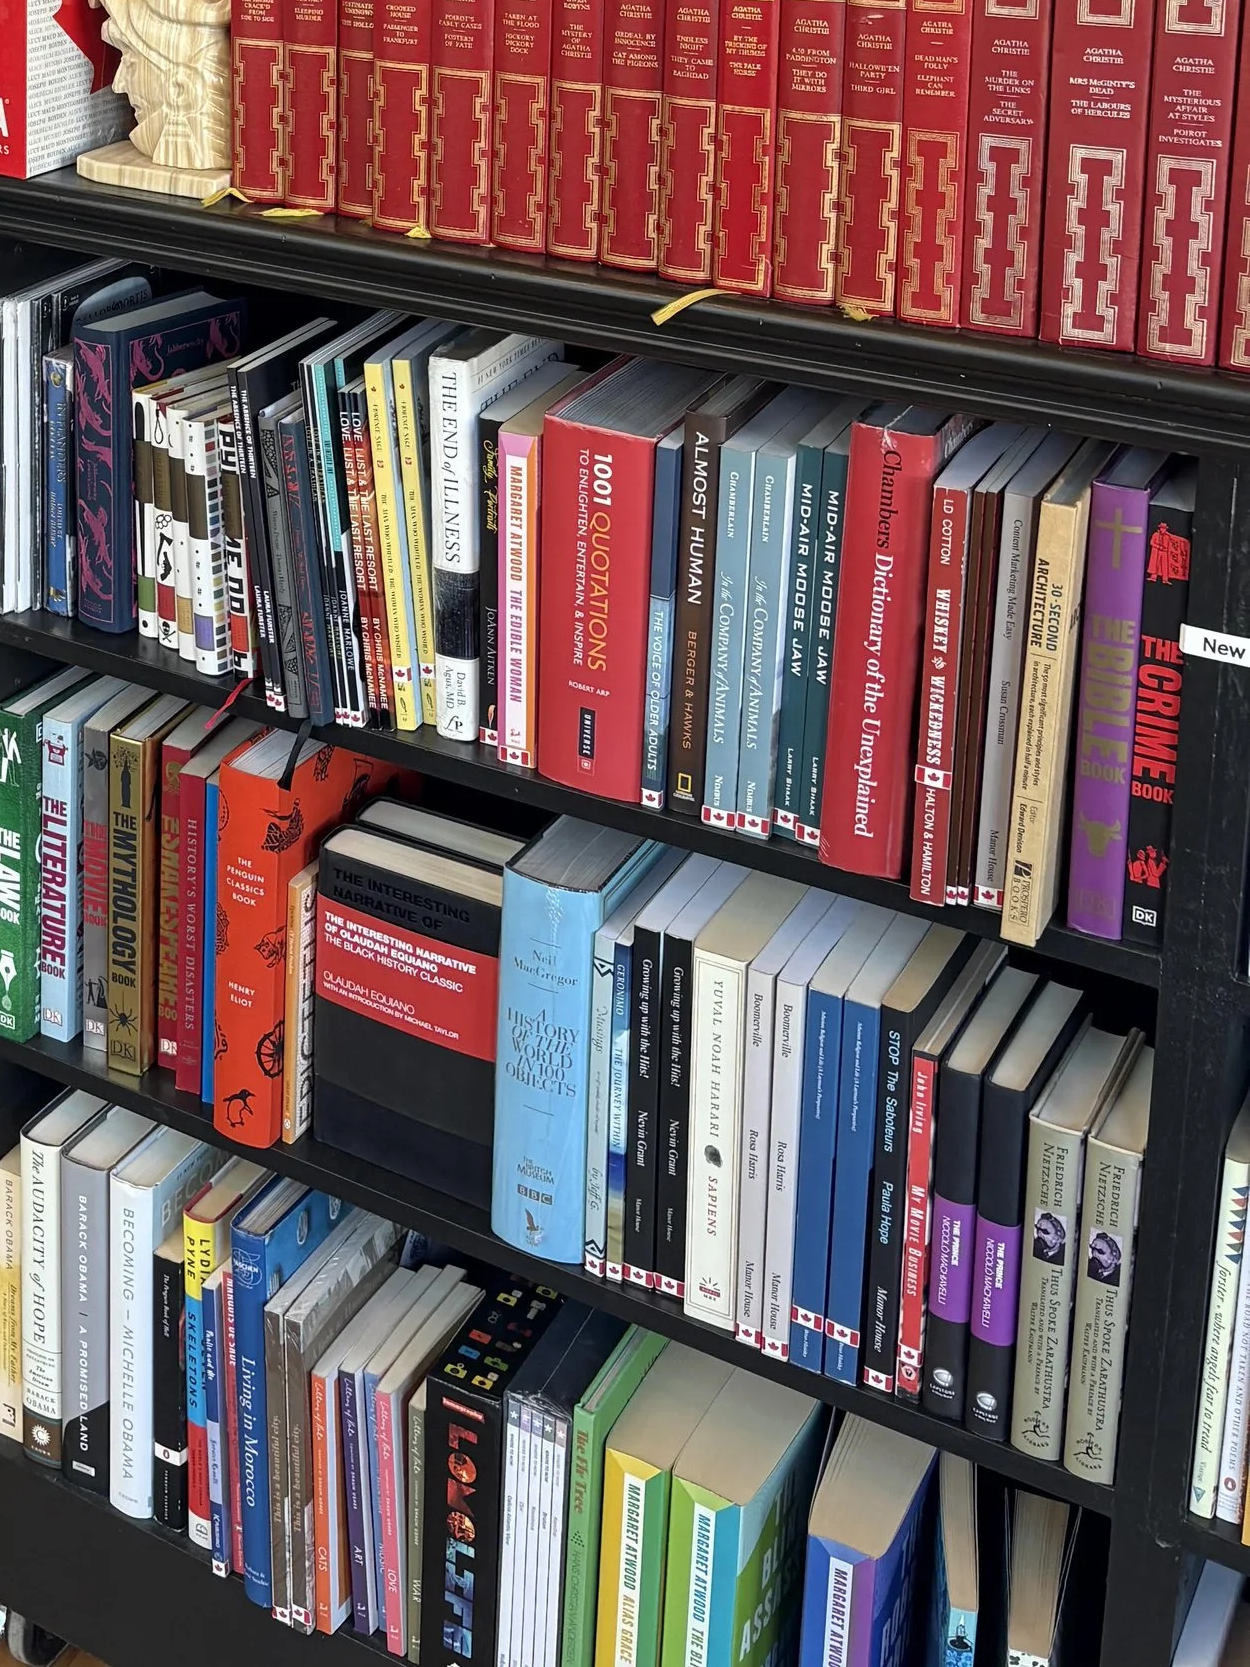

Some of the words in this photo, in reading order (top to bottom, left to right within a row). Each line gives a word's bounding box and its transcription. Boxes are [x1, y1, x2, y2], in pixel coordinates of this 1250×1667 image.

[1083, 55, 1124, 64] CHRISTIE
[1085, 48, 1122, 56] AGATHA
[1173, 65, 1215, 74] CHRISTIE
[1175, 57, 1214, 65] AGATHA
[1071, 99, 1088, 107] THE
[1091, 101, 1131, 111] LABOURS
[1089, 86, 1114, 95] DEAD
[1164, 95, 1221, 106] MYSTERIOUS
[1175, 105, 1208, 113] AFFAIR
[1183, 89, 1201, 97] THE
[1085, 109, 1130, 119] HERCULES
[1174, 129, 1207, 137] POIROT
[1182, 114, 1215, 122] STYLES
[1159, 135, 1222, 147] INVESTIGATES
[441, 372, 457, 412] THE
[442, 418, 458, 459] END
[579, 448, 589, 466] TO
[443, 461, 456, 475] of
[593, 454, 613, 506] 1001
[692, 431, 710, 519] ALMOST
[510, 465, 523, 530] MARGARET
[577, 468, 589, 538] ENLIGHTEN,
[877, 449, 902, 550] Chambers
[943, 499, 954, 514] LD
[443, 478, 460, 563] ILLNESS
[797, 483, 813, 557] MID-AIR
[509, 532, 522, 582] ATWOOD
[940, 519, 953, 566] COTTON
[573, 540, 586, 606] ENTERTAIN,
[687, 526, 705, 604] HUMAN
[510, 590, 522, 611] THE
[587, 511, 611, 672] QUOTATIONS
[793, 563, 808, 632] MOOSE
[864, 552, 894, 657] Dictionary
[1030, 557, 1050, 648] ARCHITECTURE
[510, 614, 522, 654] EDIBLE
[574, 610, 584, 618] &
[933, 588, 951, 654] WHISKEY
[573, 622, 584, 666] INSPIRE
[685, 630, 697, 687] BERGER
[790, 638, 806, 677] JAW
[1142, 634, 1184, 665] THE
[1203, 636, 1246, 659] New
[510, 657, 522, 703] WOMAN
[568, 680, 595, 693] ROBERT
[596, 688, 610, 697] ARP
[866, 659, 885, 685] of
[684, 689, 694, 698] &
[864, 680, 884, 713] the
[682, 702, 693, 749] HAWKS
[926, 675, 946, 766] WICKEDNESS
[1132, 664, 1182, 784] CRIME
[854, 719, 881, 837] Unexplained
[1131, 781, 1174, 804] BOOK
[43, 796, 67, 817] THE
[113, 811, 137, 831] THE
[923, 787, 936, 829] HALTON
[924, 832, 934, 840] &
[187, 819, 197, 898] HISTORY'S
[226, 866, 265, 883] PENGUIN
[237, 857, 252, 868] THE
[920, 841, 934, 895] HAMILTON
[41, 813, 67, 968] LITERATURE
[112, 828, 137, 975] MYTHOLOGY
[226, 877, 265, 896] CLASSICS
[232, 892, 256, 906] BOOK
[186, 903, 196, 952] WORST
[325, 911, 344, 926] THE
[346, 919, 413, 953] INTERESTING
[416, 946, 477, 975] NARRATIVE
[324, 933, 343, 948] THE
[344, 939, 375, 961] BLACK
[377, 954, 418, 977] HISTORY
[421, 970, 463, 993] CLASSIC
[325, 923, 338, 934] OF
[340, 927, 388, 955] OLAUDAH
[391, 948, 438, 973] EQUIANO
[532, 949, 557, 968] Neil
[41, 962, 66, 980] BOOK
[112, 972, 136, 988] BOOK
[228, 981, 255, 996] HENRY
[513, 956, 578, 987] MacGregor
[185, 956, 195, 1031] DISASTERS
[230, 994, 252, 1008] ELIOT
[323, 970, 369, 997] OLAUDAH
[371, 989, 415, 1015] EQUIANO
[713, 980, 724, 1025] YUVAL
[711, 1032, 721, 1075] NOAH
[887, 1029, 900, 1066] STOP
[886, 1068, 899, 1093] The
[916, 1071, 928, 1100] John
[709, 1079, 721, 1138] HARARI
[884, 1096, 898, 1153] Saboteurs
[912, 1100, 926, 1134] Irving
[30, 1149, 44, 1176] The
[707, 1175, 718, 1237] SAPIENS
[880, 1180, 894, 1210] Paula
[32, 1173, 45, 1271] AUDACITY
[78, 1195, 87, 1248] BARACK
[879, 1211, 892, 1245] Hope
[123, 1207, 135, 1301] BECOMING
[29, 1271, 46, 1292] of
[78, 1250, 88, 1303] OBAMA
[32, 1291, 46, 1345] HOPE
[78, 1325, 87, 1335] A
[78, 1339, 89, 1412] PROMISED
[122, 1324, 135, 1412] MICHELLE
[241, 1355, 256, 1406] Living
[80, 1415, 89, 1452] LAND
[241, 1410, 253, 1427] in
[121, 1417, 135, 1480] OBAMA
[243, 1427, 257, 1508] Morocco
[627, 1483, 641, 1544] MARGARET
[317, 1546, 328, 1572] CATS
[623, 1545, 638, 1591] ATWOOD
[621, 1594, 635, 1627] ALIAS
[619, 1628, 634, 1665] GRACE
